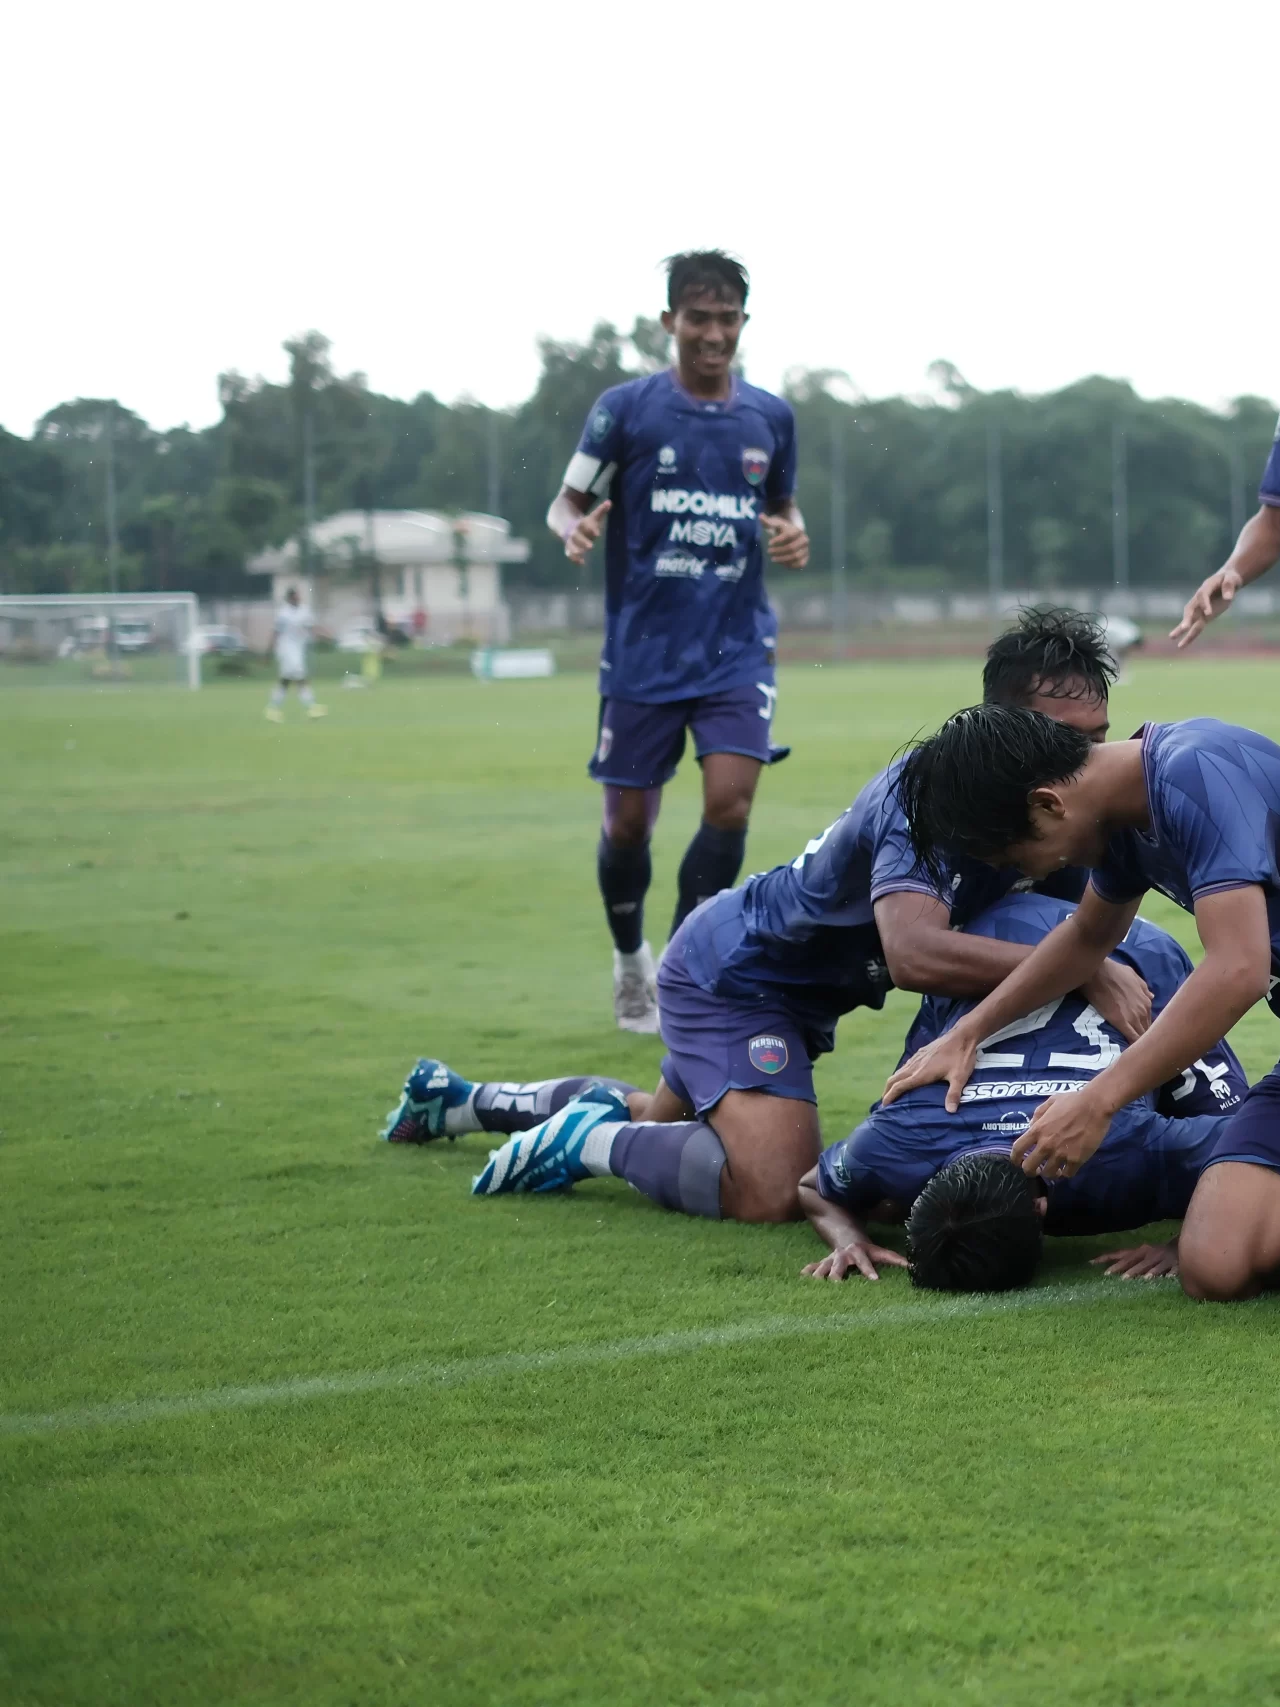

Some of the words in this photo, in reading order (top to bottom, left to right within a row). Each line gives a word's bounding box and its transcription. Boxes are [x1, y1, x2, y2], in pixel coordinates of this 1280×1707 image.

[651, 488, 757, 520] INDOMILK
[669, 519, 738, 548] MOYA
[751, 1037, 784, 1051] PERSITA
[1220, 1094, 1241, 1111] MILLS
